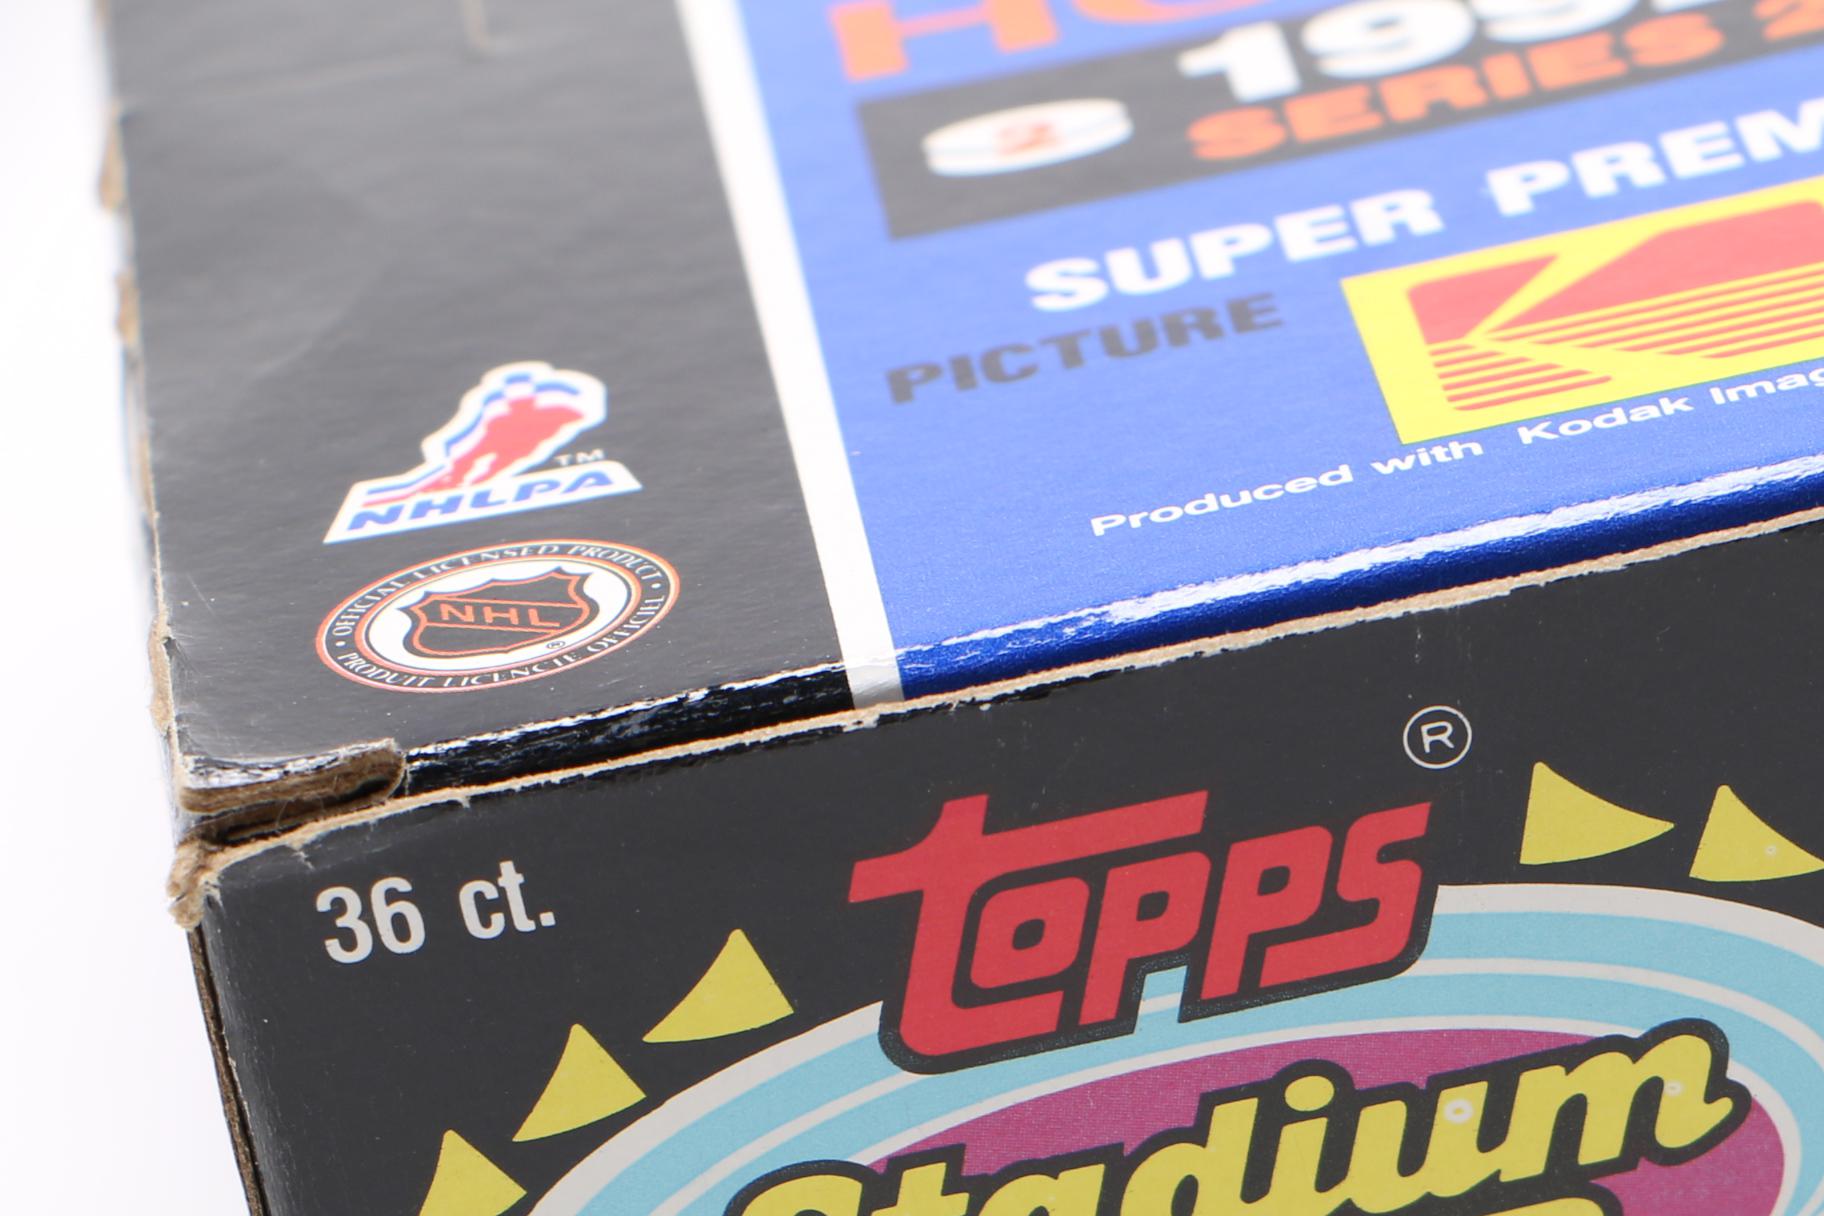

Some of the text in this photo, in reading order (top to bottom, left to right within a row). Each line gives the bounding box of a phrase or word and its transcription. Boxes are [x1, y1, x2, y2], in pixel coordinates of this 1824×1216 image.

[1187, 12, 1726, 161] SERIES
[1025, 188, 1445, 313] SUPER
[885, 293, 1283, 405] PICTURE
[346, 470, 614, 531] NHLPA
[1090, 463, 1354, 537] Produced
[1370, 438, 1485, 476] with
[1518, 394, 1695, 446] Kodak
[333, 544, 661, 637] OFFICIAL LICENSED PRODUCT
[439, 603, 561, 628] NHL
[336, 652, 436, 688] PRODUIT
[316, 860, 556, 964] 36 ct.
